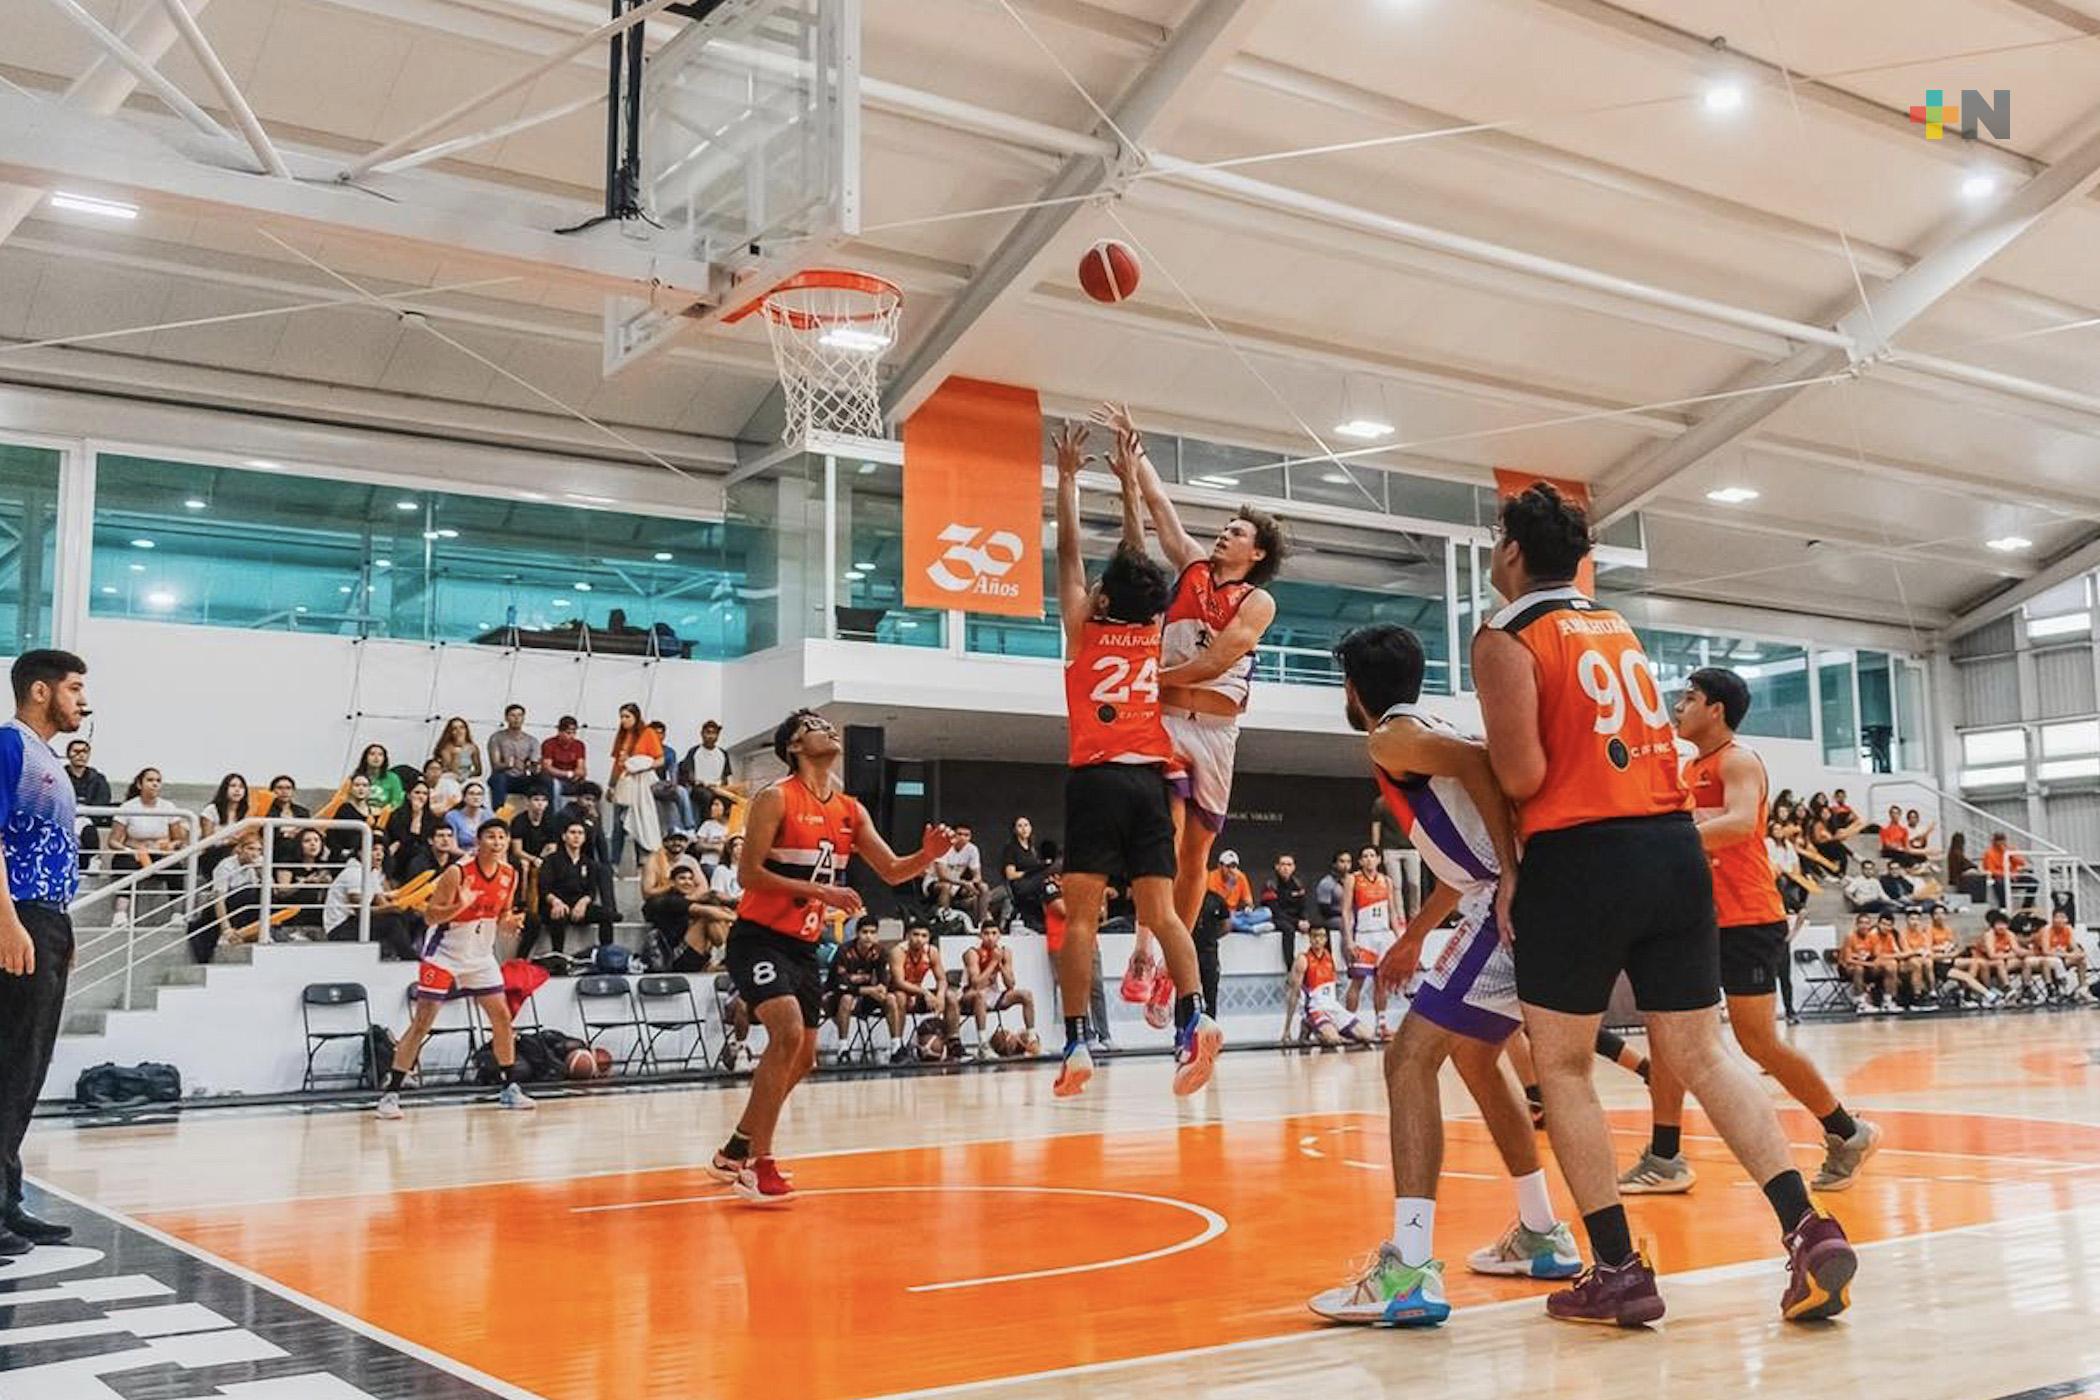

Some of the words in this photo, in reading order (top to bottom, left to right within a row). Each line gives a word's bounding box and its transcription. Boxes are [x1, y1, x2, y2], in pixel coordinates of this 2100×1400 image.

[926, 523, 1023, 592] 30
[973, 576, 1019, 597] Años
[1090, 655, 1158, 703] 24
[1577, 650, 1670, 734] 90
[753, 961, 777, 985] 8
